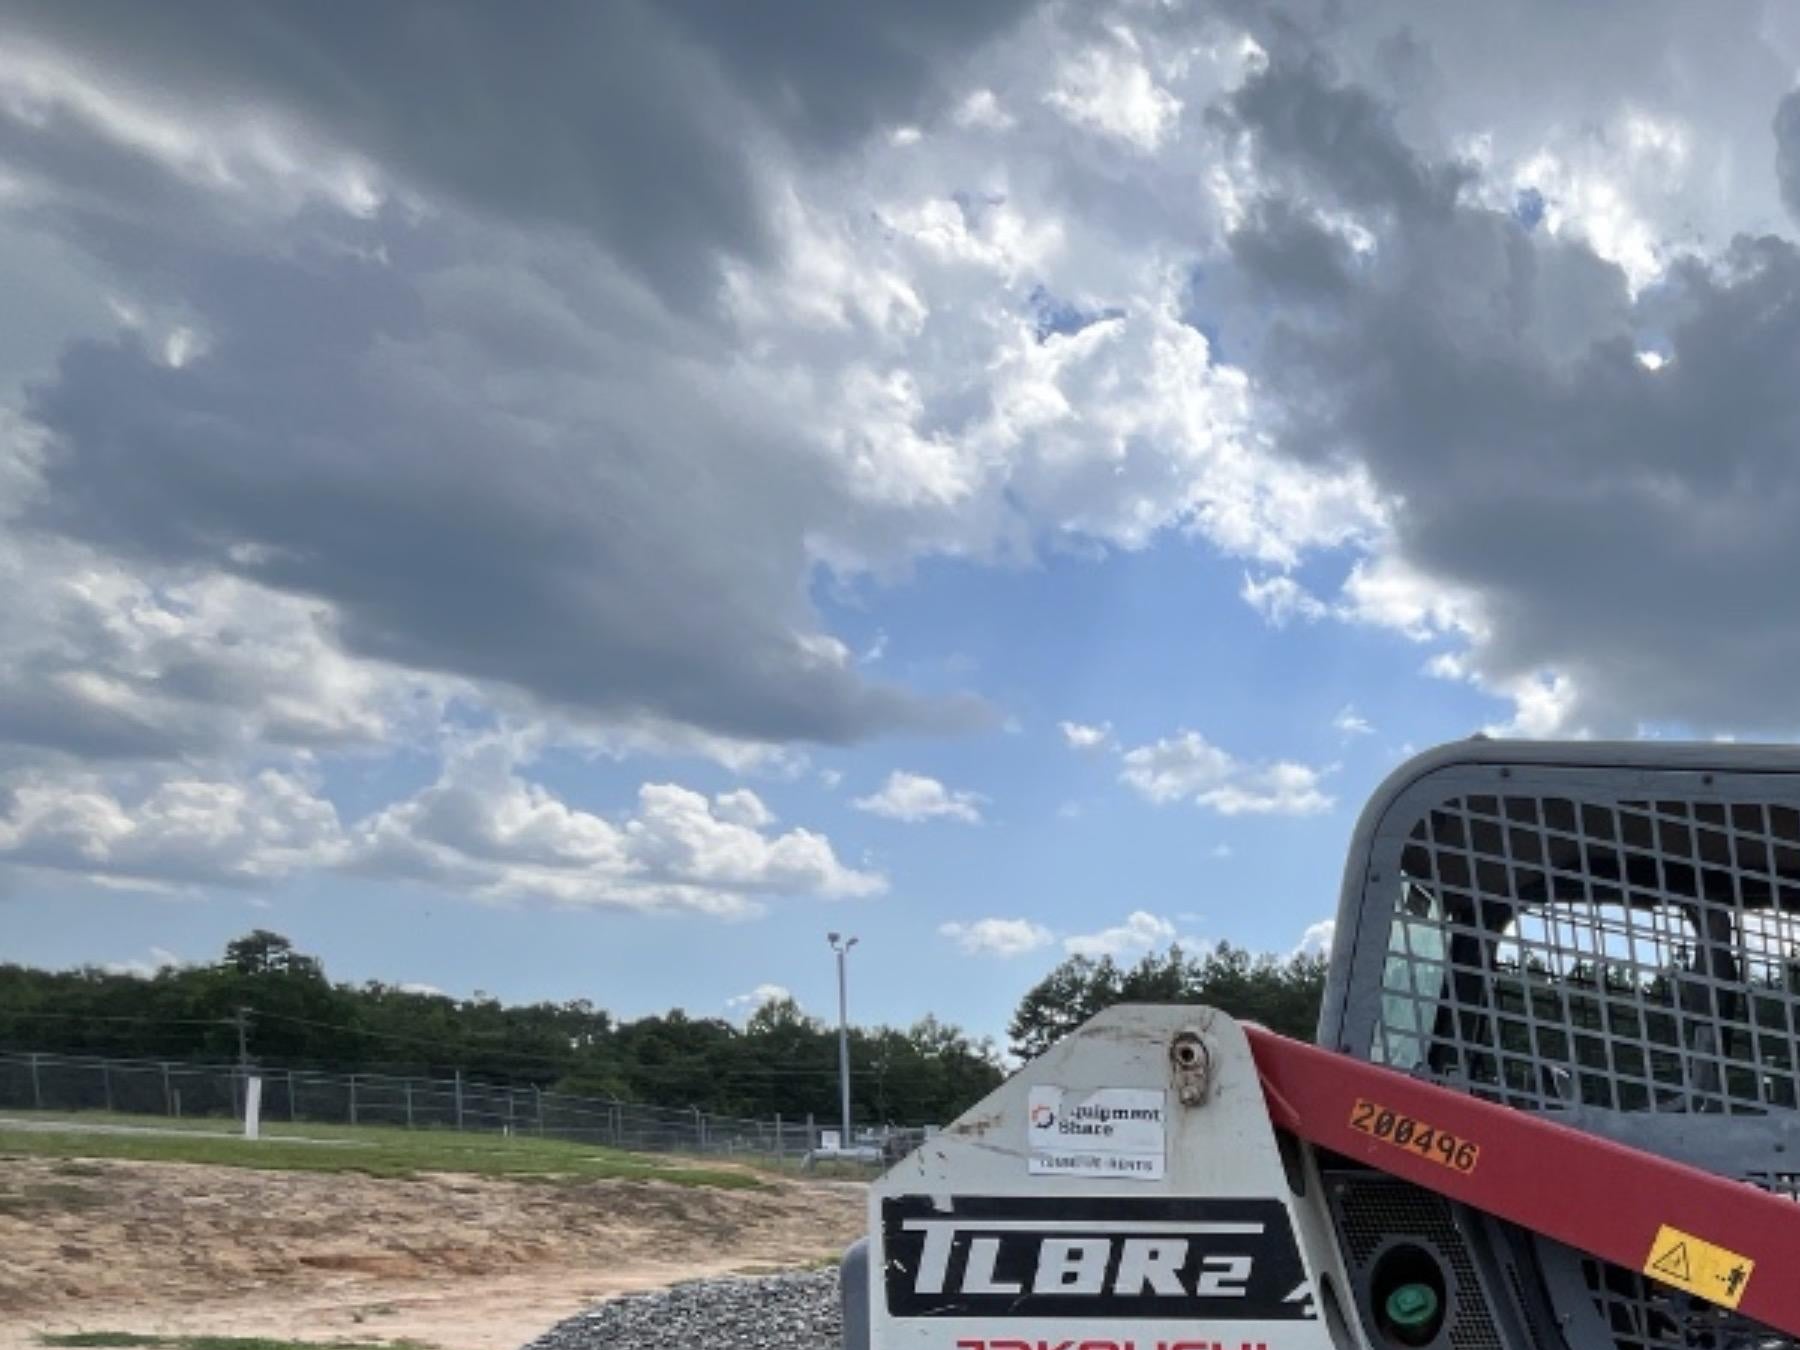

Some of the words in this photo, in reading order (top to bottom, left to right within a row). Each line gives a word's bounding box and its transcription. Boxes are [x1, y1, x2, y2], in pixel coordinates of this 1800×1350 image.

[1059, 1104, 1160, 1122] quipment
[1059, 1119, 1113, 1136] Share
[1352, 1102, 1477, 1171] 200496
